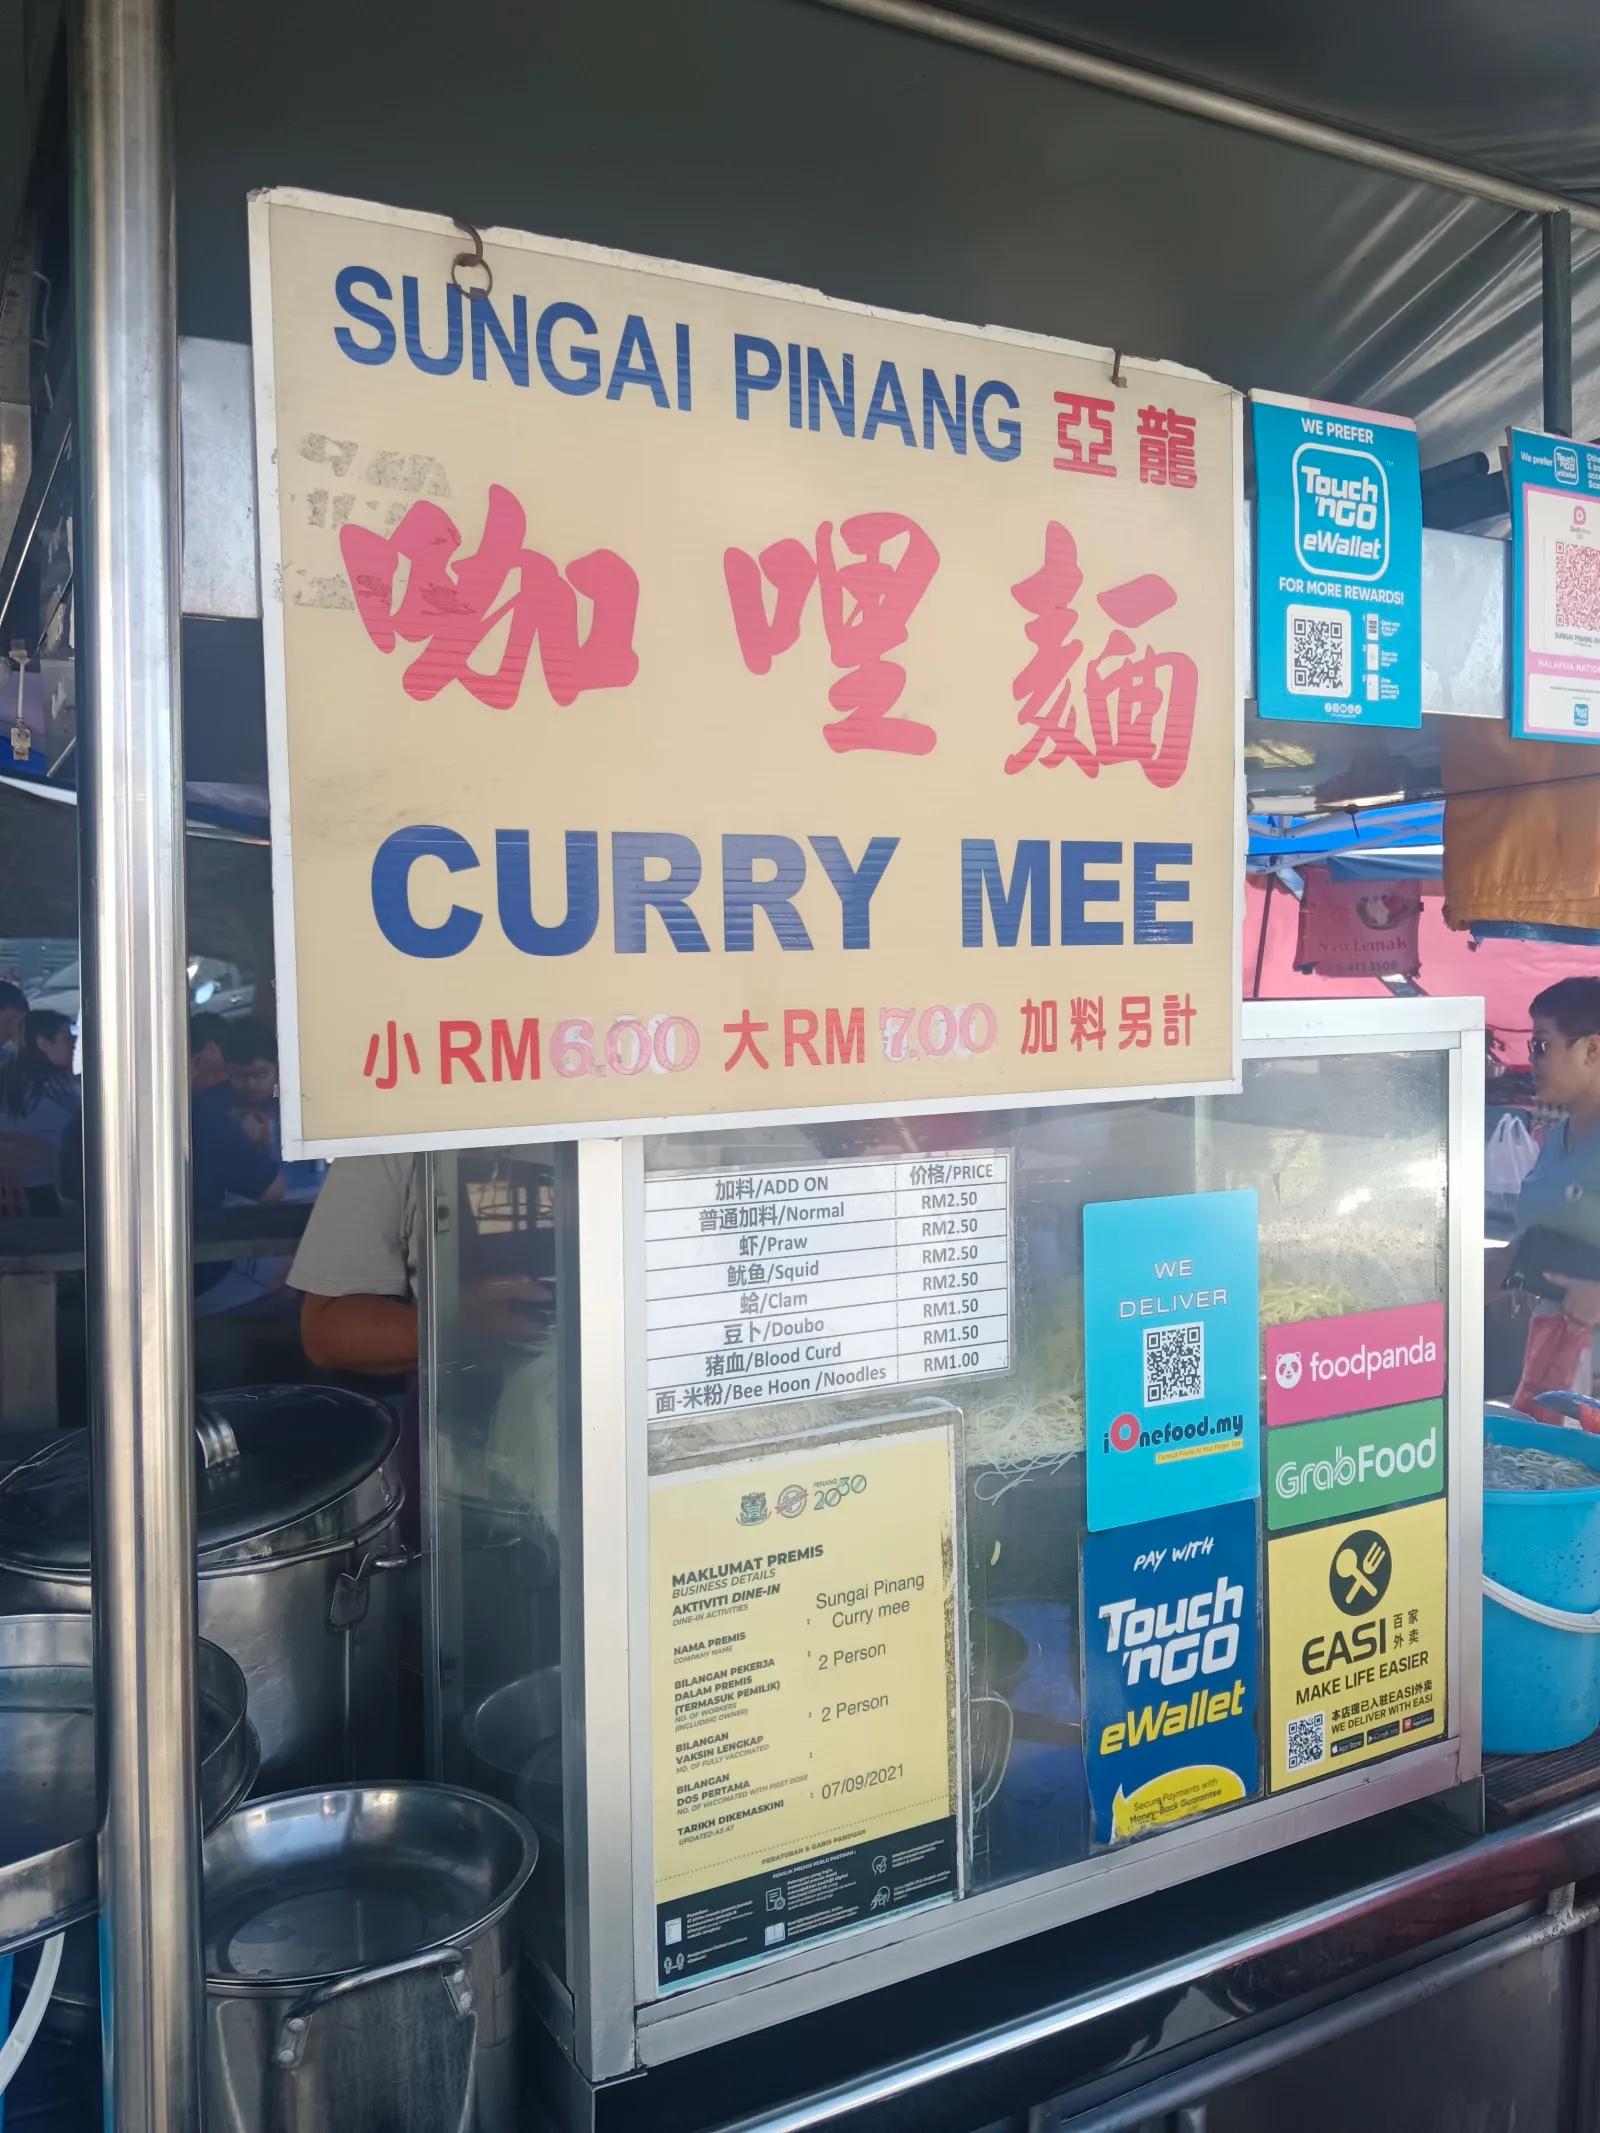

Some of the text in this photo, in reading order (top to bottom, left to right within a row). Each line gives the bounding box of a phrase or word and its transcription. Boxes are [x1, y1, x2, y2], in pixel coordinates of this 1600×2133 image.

[334, 265, 1023, 463] SUNGAI PINANG
[1052, 390, 1199, 489] 亞龍
[1301, 417, 1374, 444] WE PREFER
[1520, 452, 1553, 467] We prefer
[1301, 465, 1379, 503] Touch
[1303, 531, 1381, 560] eWallet
[1279, 576, 1405, 605] FOR MORE REWARDS!
[1554, 631, 1574, 641] SUNGAI
[1538, 658, 1575, 671] MALAYSIA
[370, 824, 1195, 959] CURRY MEE
[1353, 935, 1407, 953] Lemak
[362, 1019, 422, 1090] 小
[723, 1007, 770, 1072] 大
[1019, 992, 1198, 1056] 加料另計
[715, 1175, 829, 1202] 加料/ADD ON
[909, 1163, 994, 1187] 价格/PRICE
[921, 1191, 978, 1210] RM2.50
[699, 1201, 845, 1232] 普通加料/Normal
[921, 1218, 978, 1237] RM2.50
[739, 1236, 808, 1257] 虾/Praw
[922, 1245, 978, 1264] RM2.50
[727, 1261, 820, 1289] 鱿鱼/Squid
[922, 1271, 979, 1291] RM2.50
[1154, 1259, 1194, 1279] WE
[740, 1291, 808, 1315] 蛤/Clam
[923, 1298, 979, 1318] RM1.50
[1119, 1288, 1228, 1319] DELIVER
[723, 1317, 825, 1345] 豆卜/Doubo
[923, 1325, 979, 1346] RM1.50
[705, 1342, 842, 1378] 猪血/Blood Curd
[924, 1352, 979, 1372] RM1.00
[1309, 1335, 1437, 1382] foodpanda
[655, 1365, 887, 1415] 面-米粉/Bee Hoon /Noodles
[1275, 1427, 1437, 1499] GrabFood
[813, 1474, 868, 1511] 2030
[672, 1544, 825, 1587] MAKLUMAT PREMIS
[1133, 1536, 1215, 1573] PAY WITH
[672, 1568, 777, 1600] BUSINESS DETAILS
[816, 1573, 926, 1610] Sungai Pinang
[672, 1583, 782, 1617] AKTIVITI DINE-IN
[672, 1602, 749, 1627] DINE-IN ACTIVITIES
[832, 1600, 911, 1630] Curry mee
[1098, 1576, 1245, 1654] Touch
[1393, 1608, 1419, 1629] 百家
[673, 1631, 746, 1657] NAMA PREMIS
[1301, 1618, 1387, 1676] EASI
[1393, 1628, 1420, 1650] 外卖
[673, 1645, 733, 1666] COMPANY NAME
[818, 1643, 887, 1671] 2 Person
[674, 1658, 776, 1690] BILANGAN PEKERJA
[1296, 1650, 1429, 1705] MAKE LIFE EASIER
[674, 1675, 753, 1702] DALAM PREMIS
[674, 1681, 782, 1717] (TERMASUK PEMILIK)
[690, 1711, 701, 1720] OF
[701, 1701, 738, 1717] WORKERS
[717, 1708, 749, 1723] OWNER)
[821, 1695, 890, 1723] 2 Person
[1100, 1679, 1247, 1756] eWallet
[1331, 1722, 1346, 1734] WE
[1348, 1709, 1386, 1730] DELIVER
[1388, 1702, 1412, 1716] WITH
[1413, 1693, 1433, 1708] EASI
[675, 1732, 730, 1753] BILANGAN
[676, 1735, 765, 1765] VAKSIN LENGKAP
[690, 1761, 702, 1771] OF
[702, 1754, 725, 1768] FULLY
[725, 1743, 770, 1761] VACCINATED
[676, 1773, 731, 1795] BILANGAN
[676, 1780, 750, 1807] DOS PERTAMA
[749, 1785, 768, 1797] WITH
[768, 1779, 785, 1791] FIRST
[785, 1774, 809, 1787] DOSE
[821, 1763, 905, 1800] 07/09/2021
[1162, 1782, 1201, 1803] Payments
[1201, 1777, 1219, 1790] with
[677, 1799, 785, 1836] TARIKH DIKEMASKINI
[678, 1824, 735, 1846] UPDATED AS AT
[761, 1848, 804, 1866] PERATURAN
[811, 1839, 833, 1852] GARIS
[833, 1828, 867, 1845] PANDUAN
